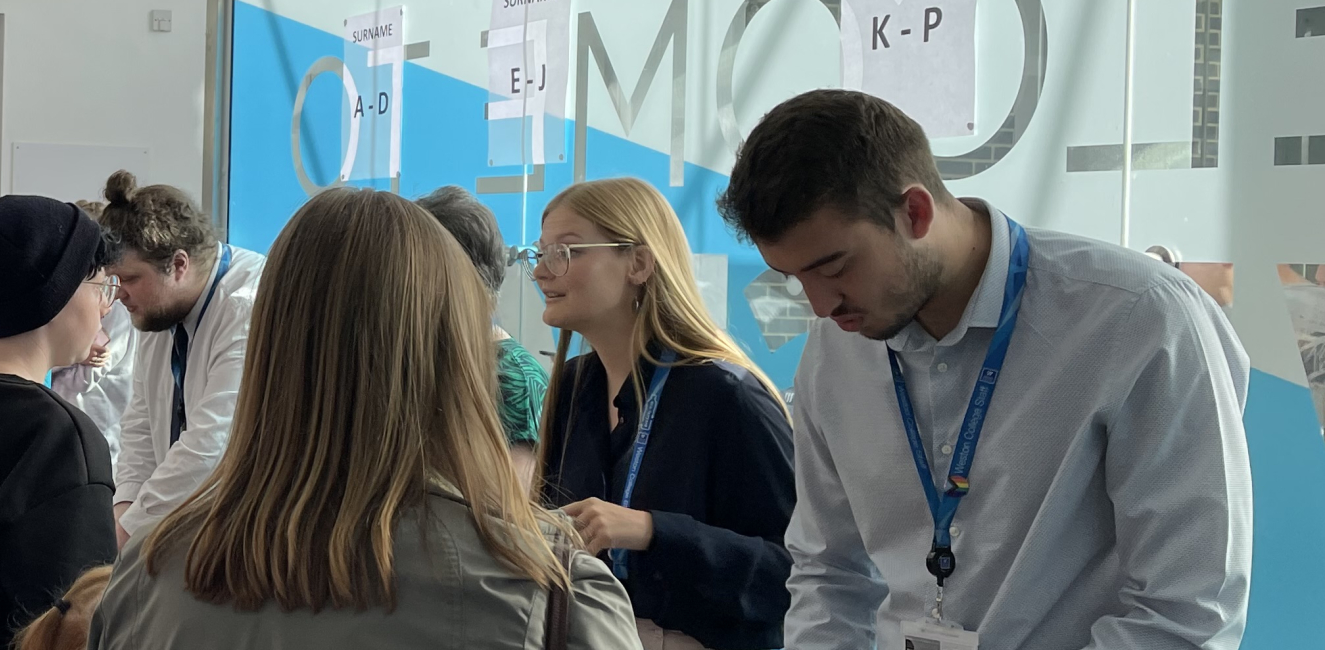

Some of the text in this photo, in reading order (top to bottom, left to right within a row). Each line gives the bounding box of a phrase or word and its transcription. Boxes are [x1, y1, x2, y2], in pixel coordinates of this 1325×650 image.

[352, 23, 393, 44] SURNAME
[954, 386, 989, 474] Weston College Staff
